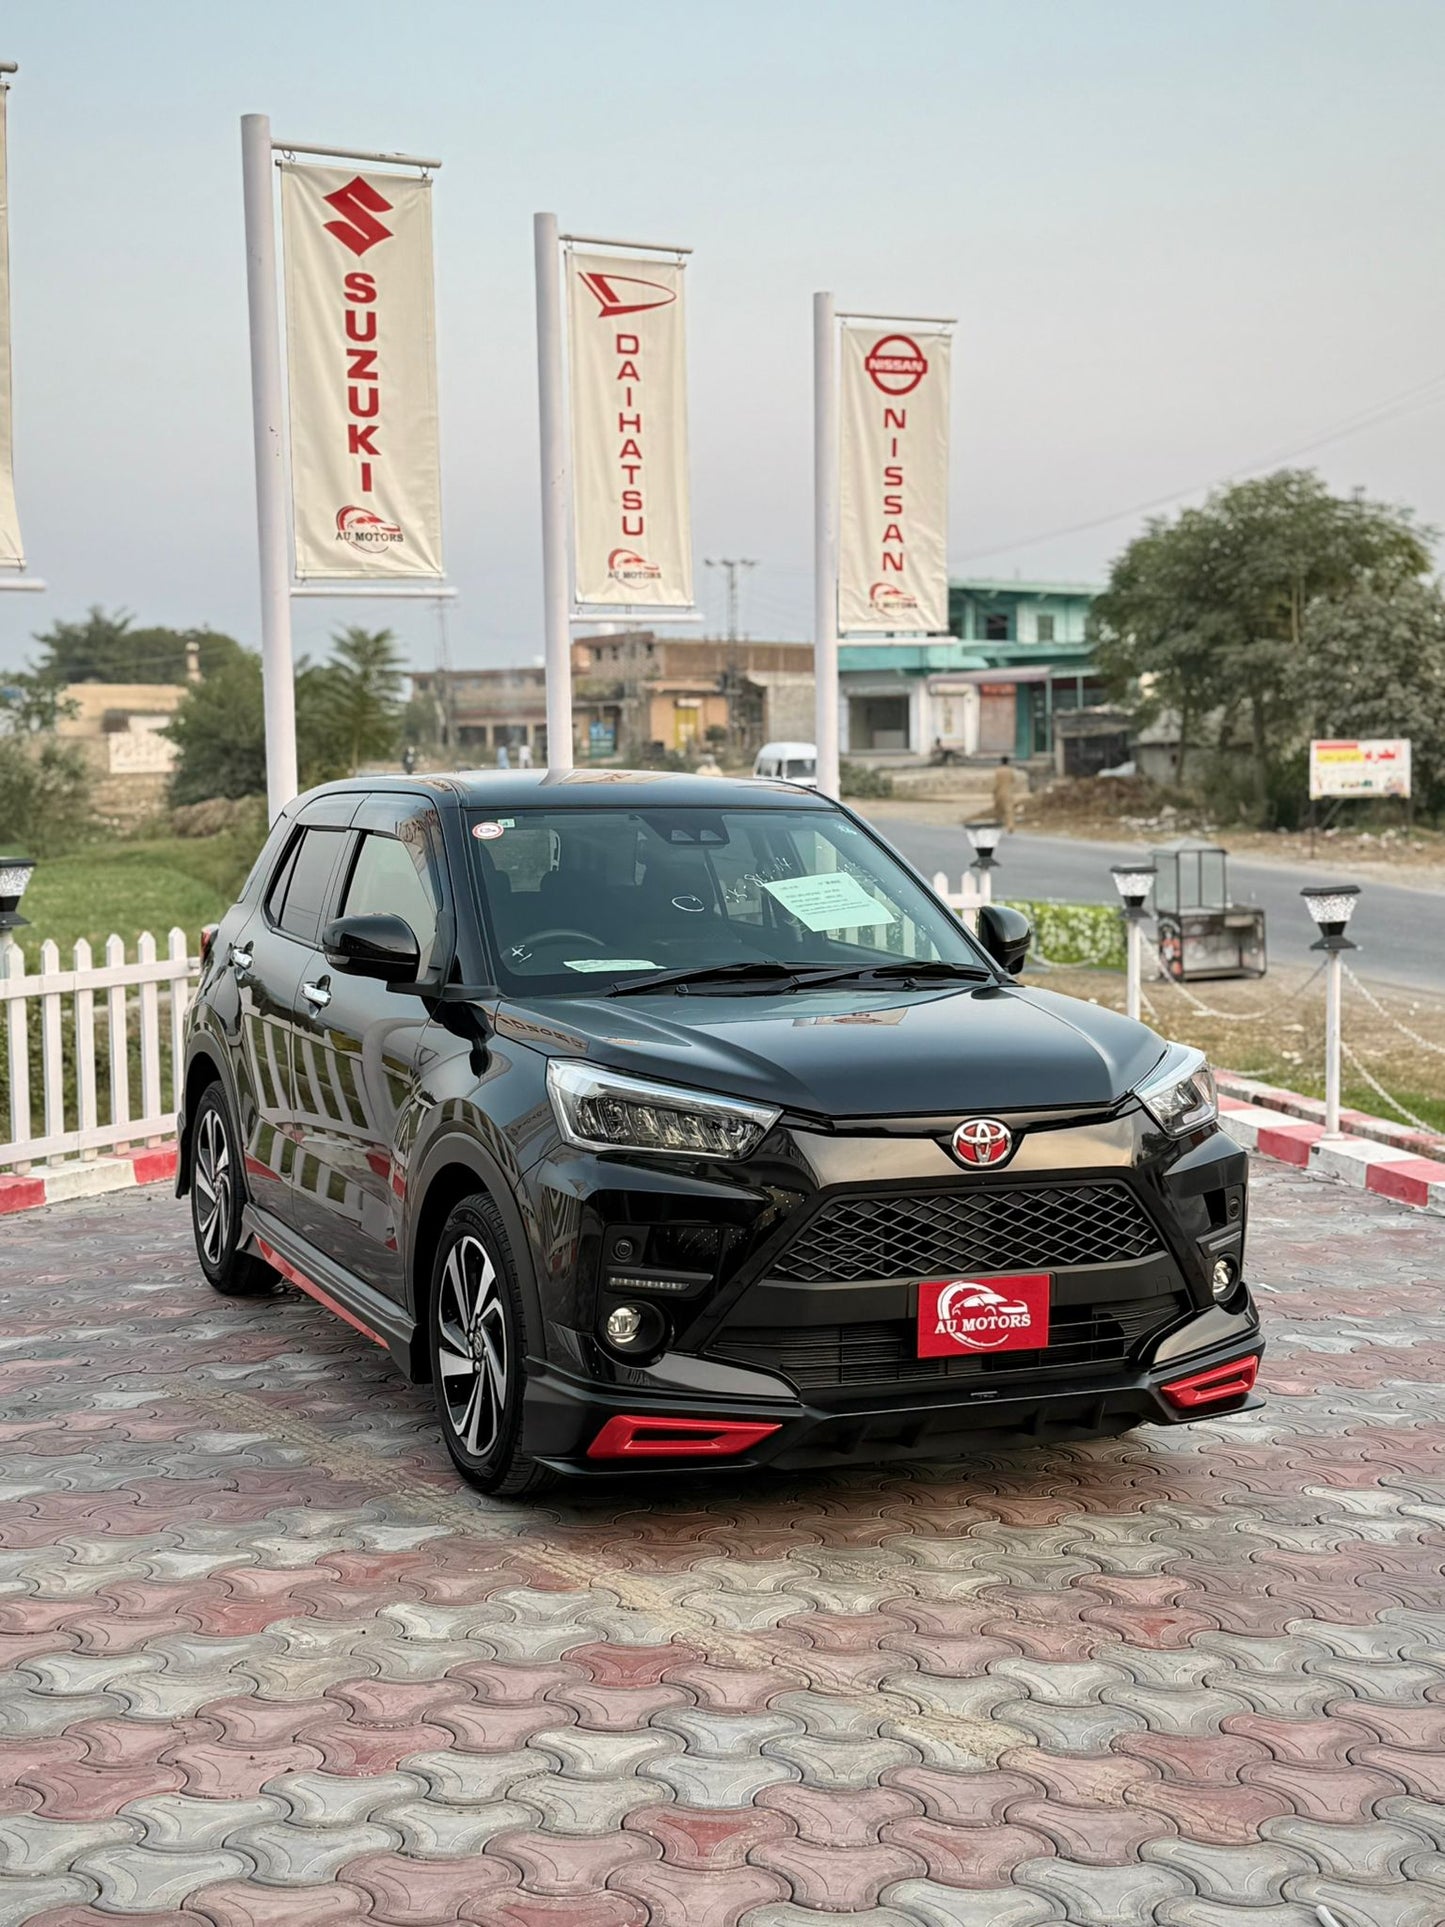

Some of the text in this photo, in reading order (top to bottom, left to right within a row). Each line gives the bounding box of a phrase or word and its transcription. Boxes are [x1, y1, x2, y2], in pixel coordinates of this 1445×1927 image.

[344, 271, 381, 492] SUZUKI
[869, 358, 924, 373] NISSAN
[616, 333, 644, 536] DAIHATSU
[882, 408, 906, 572] NISSAN
[335, 531, 404, 542] AU MOTORS
[934, 1314, 1031, 1334] AU MOTORS
